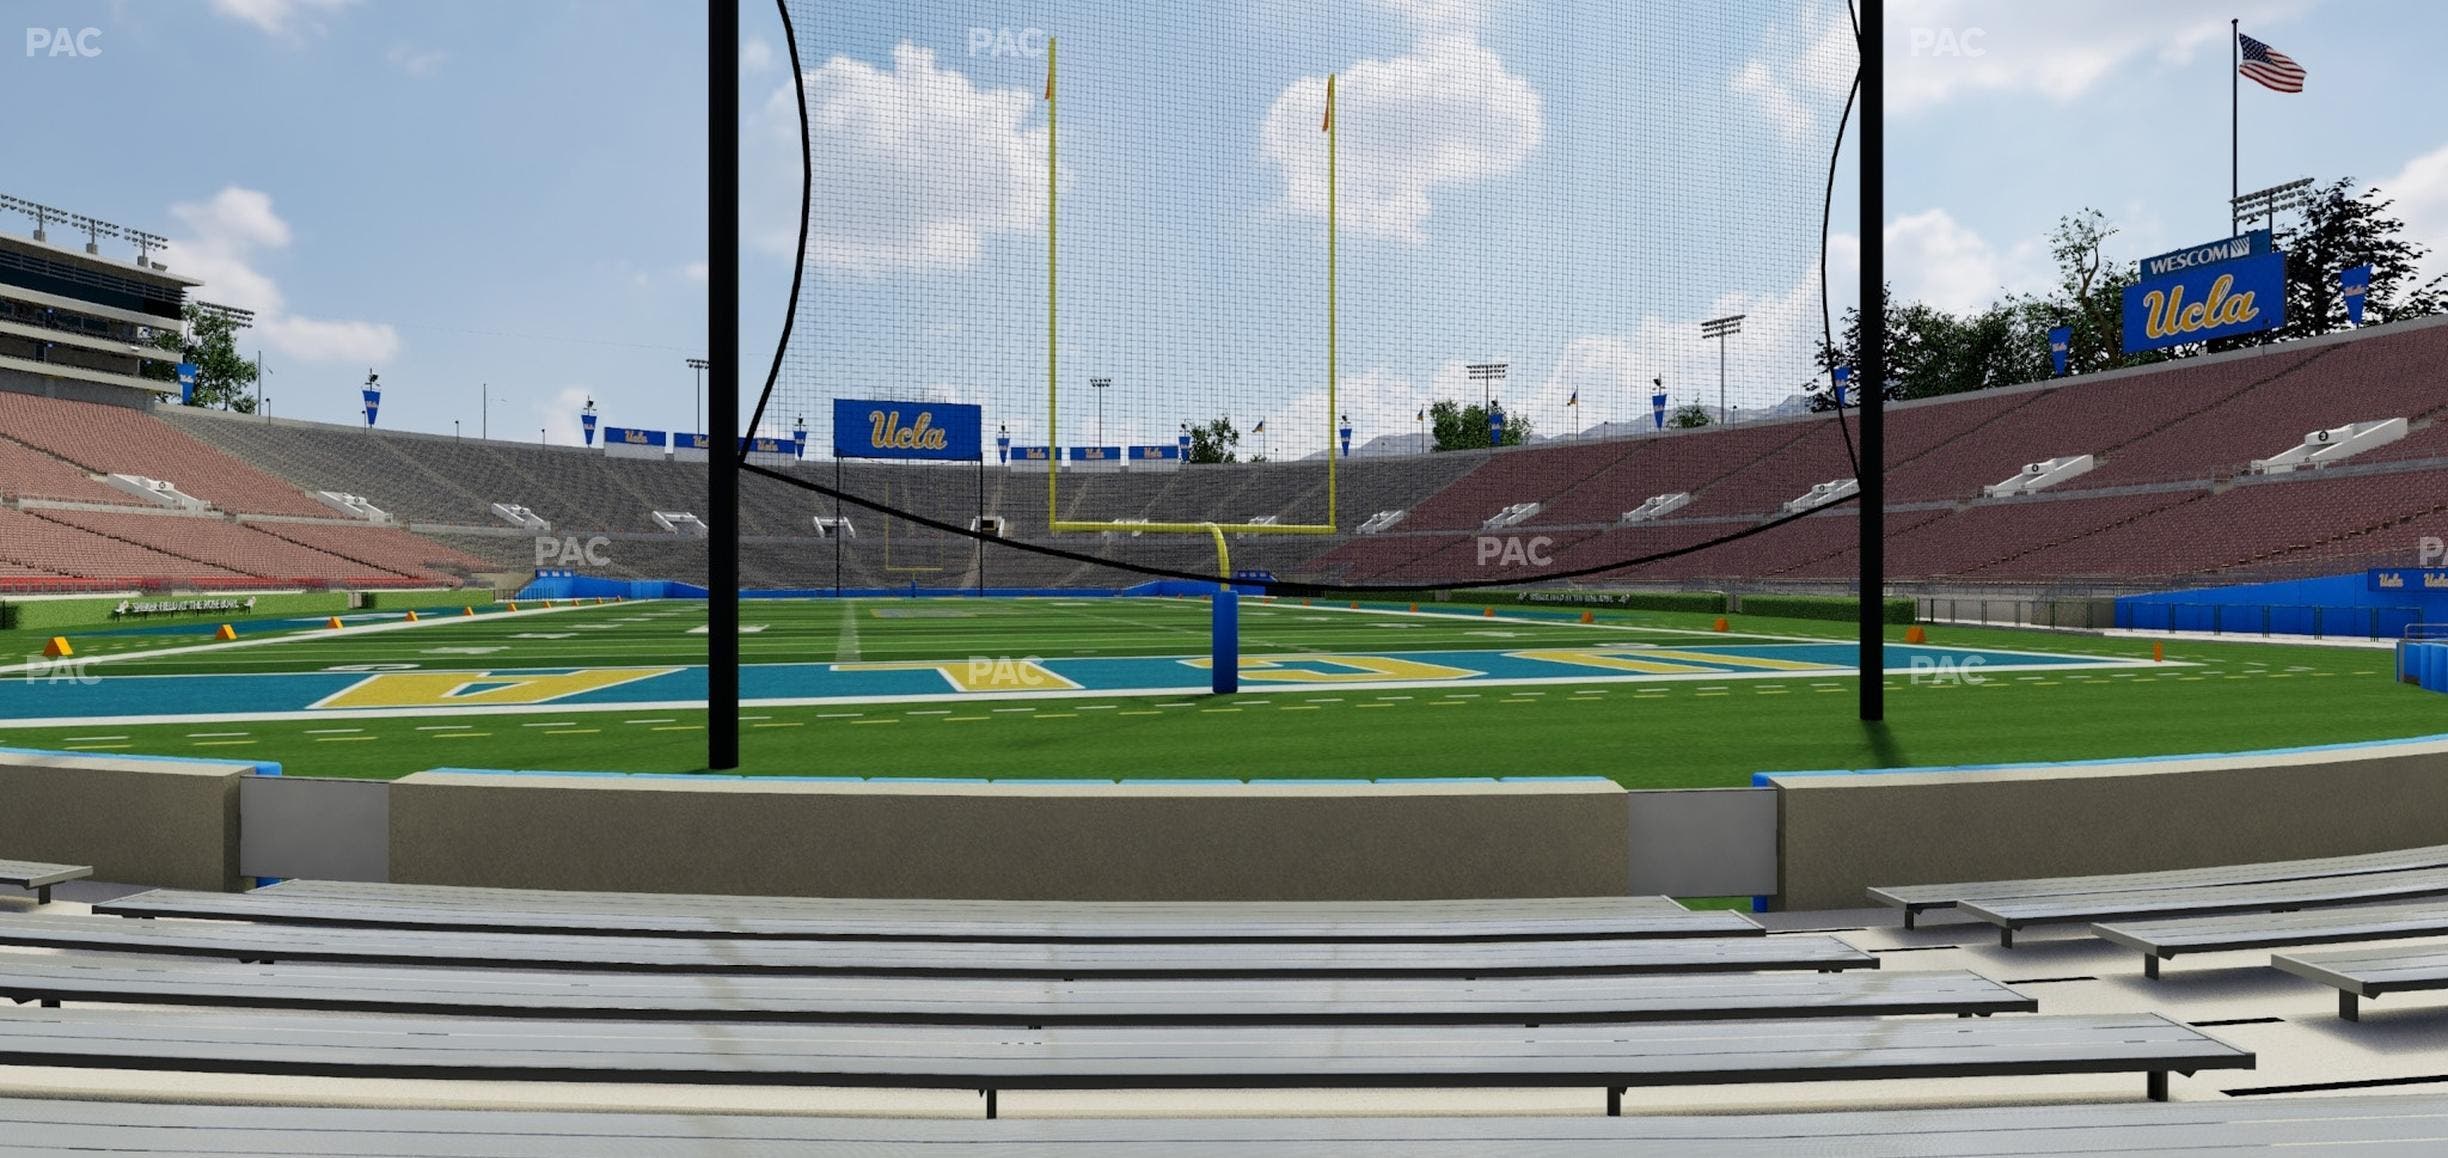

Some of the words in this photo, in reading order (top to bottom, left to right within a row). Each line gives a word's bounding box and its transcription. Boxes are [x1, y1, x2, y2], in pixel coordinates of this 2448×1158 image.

[2150, 243, 2229, 275] WESCOM
[2143, 273, 2260, 339] Ucla
[869, 410, 948, 450] Ucla
